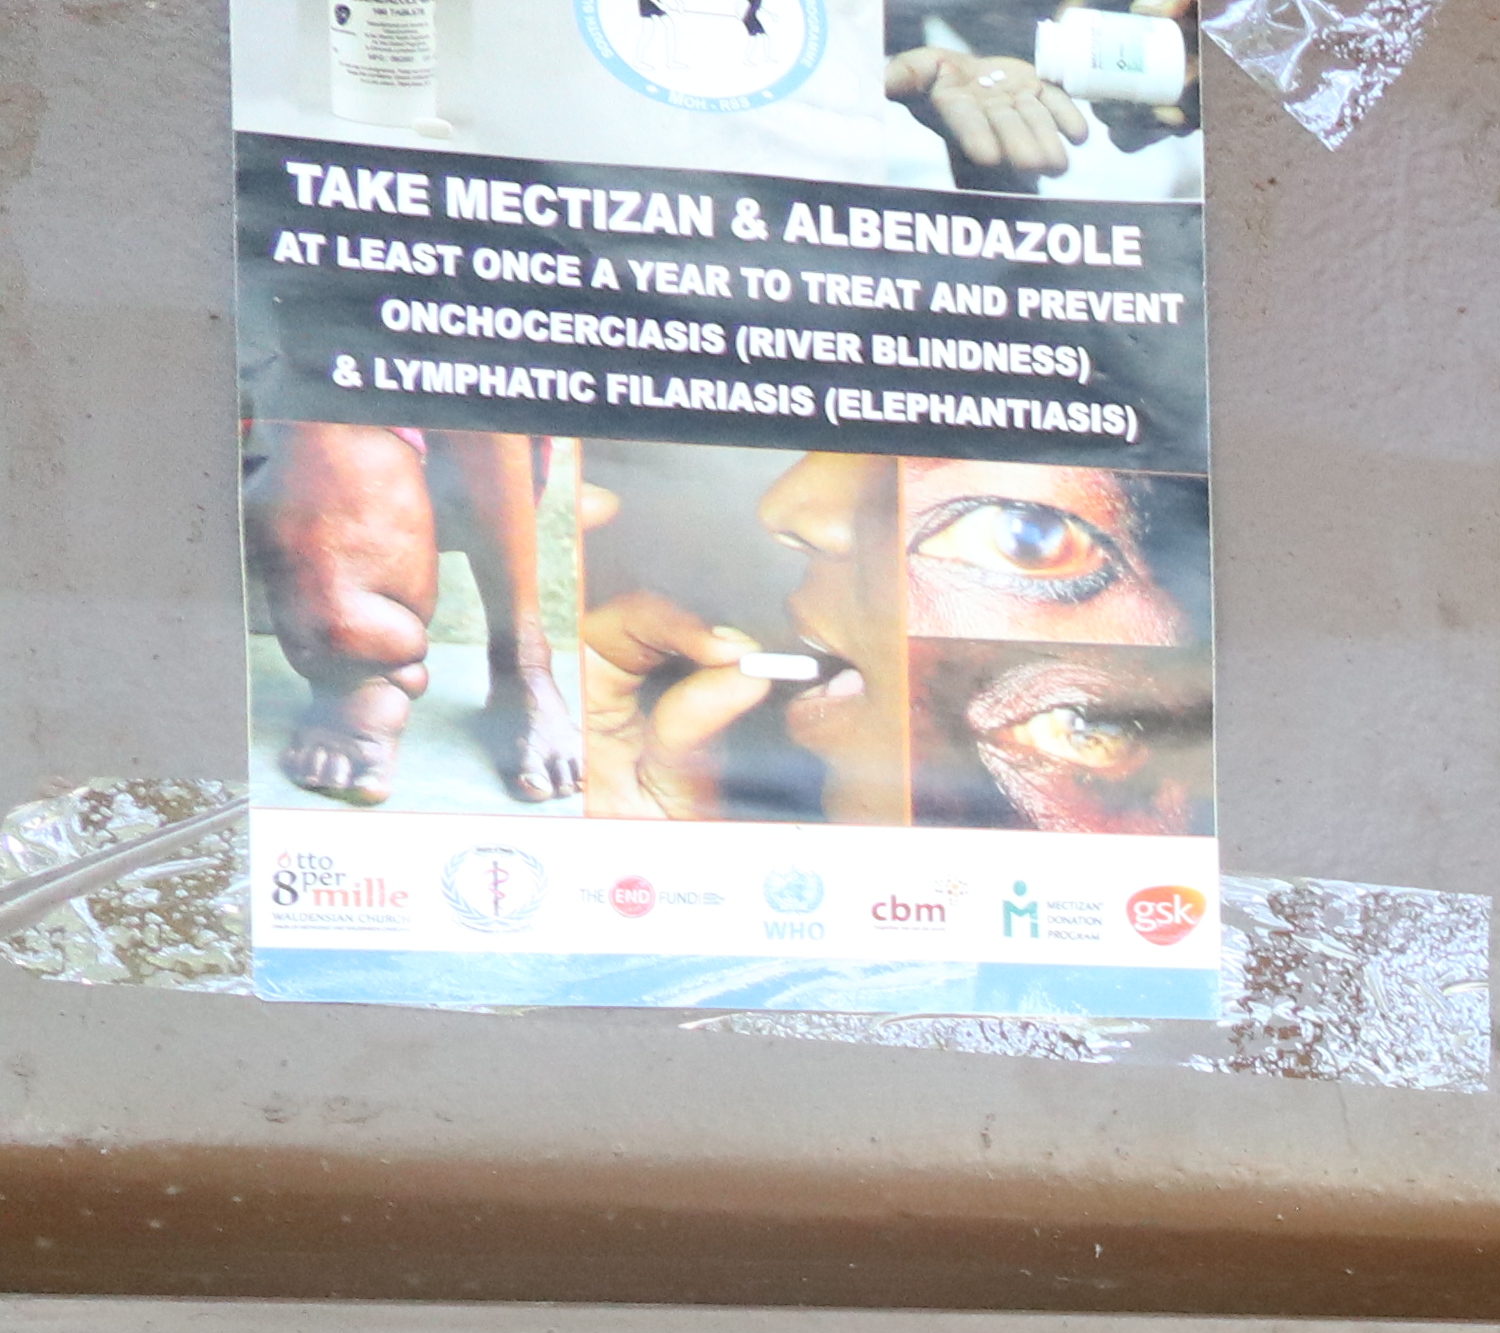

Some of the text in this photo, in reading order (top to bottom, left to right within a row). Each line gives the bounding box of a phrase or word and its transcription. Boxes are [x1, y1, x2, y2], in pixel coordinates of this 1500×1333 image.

[668, 89, 707, 110] MOH
[286, 161, 1146, 268] TAKE MECTIZAN & ALBENDAZOLE
[273, 230, 1185, 325] AT LEAST ONCE A YEAR TO TREAT AND PREVENT
[380, 298, 1092, 385] ONCHOCERCIASIS (RIVER BLINDNESS)
[332, 353, 1139, 444] & LYMPHATIC FILARIASIS (ELEPHANTIASIS)
[271, 869, 347, 907] 8 per
[311, 876, 410, 909] mille
[579, 887, 607, 905] THE
[614, 888, 651, 905] END
[658, 890, 699, 906] FUND
[271, 911, 411, 924] WALDENSIAN CHURCH
[870, 893, 947, 923] cbm
[1046, 914, 1103, 927] DONATION
[1133, 893, 1196, 933] gsk
[762, 920, 826, 941] WHO
